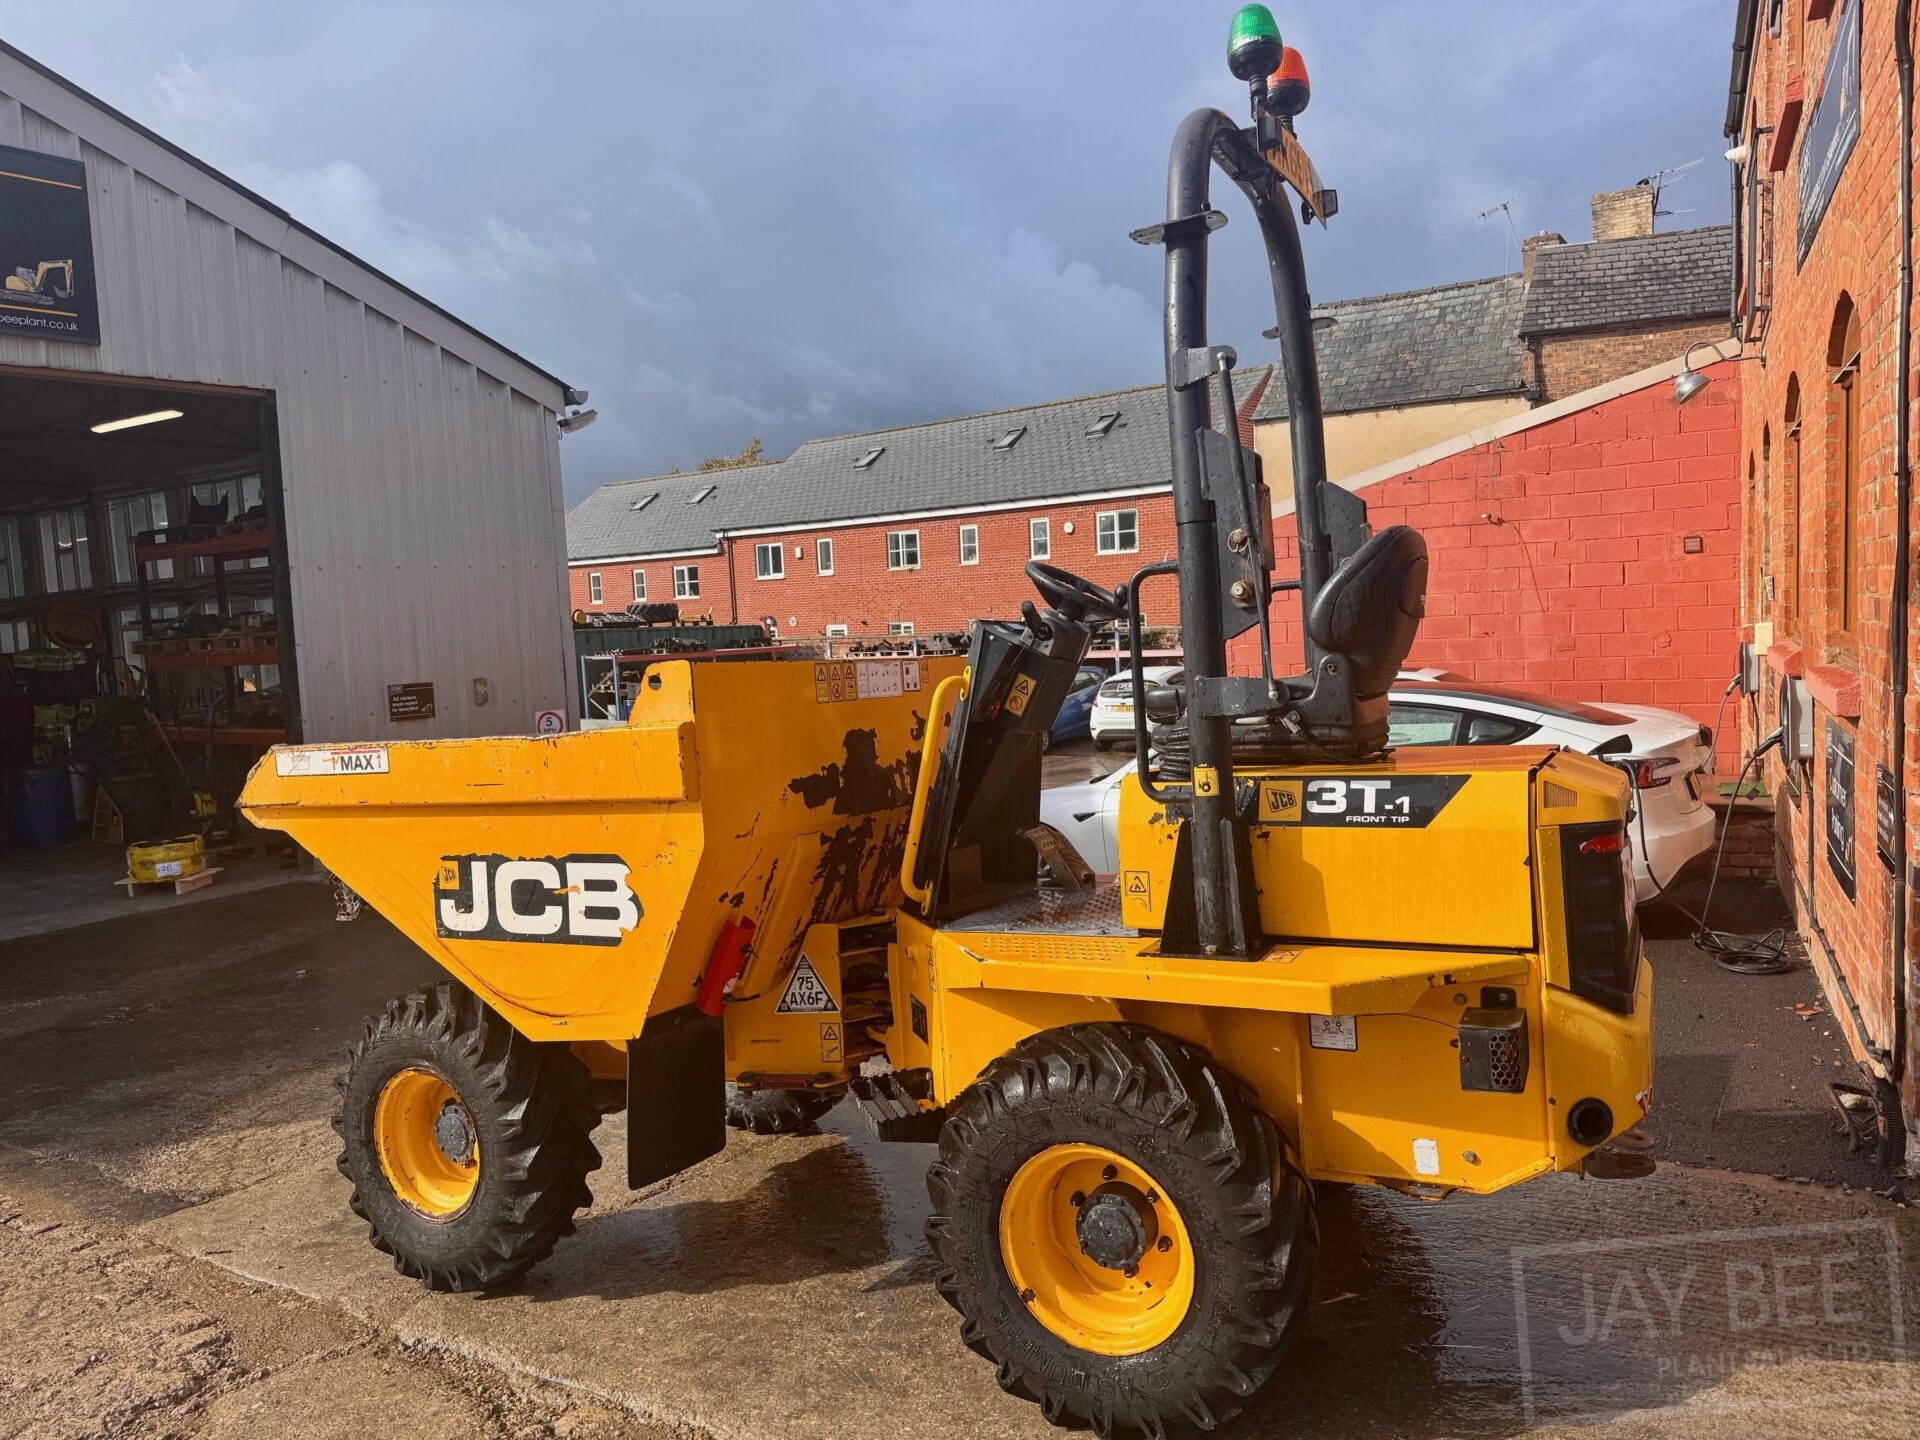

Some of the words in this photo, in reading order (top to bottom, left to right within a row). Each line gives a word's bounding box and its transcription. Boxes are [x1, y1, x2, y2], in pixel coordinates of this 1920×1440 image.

[546, 716, 553, 727] 5
[340, 754, 375, 771] MAX
[1270, 791, 1295, 810] JCB
[1346, 815, 1388, 823] FRONT
[439, 861, 639, 938] JCB
[797, 976, 814, 991] 75
[789, 992, 824, 1006] AX6F
